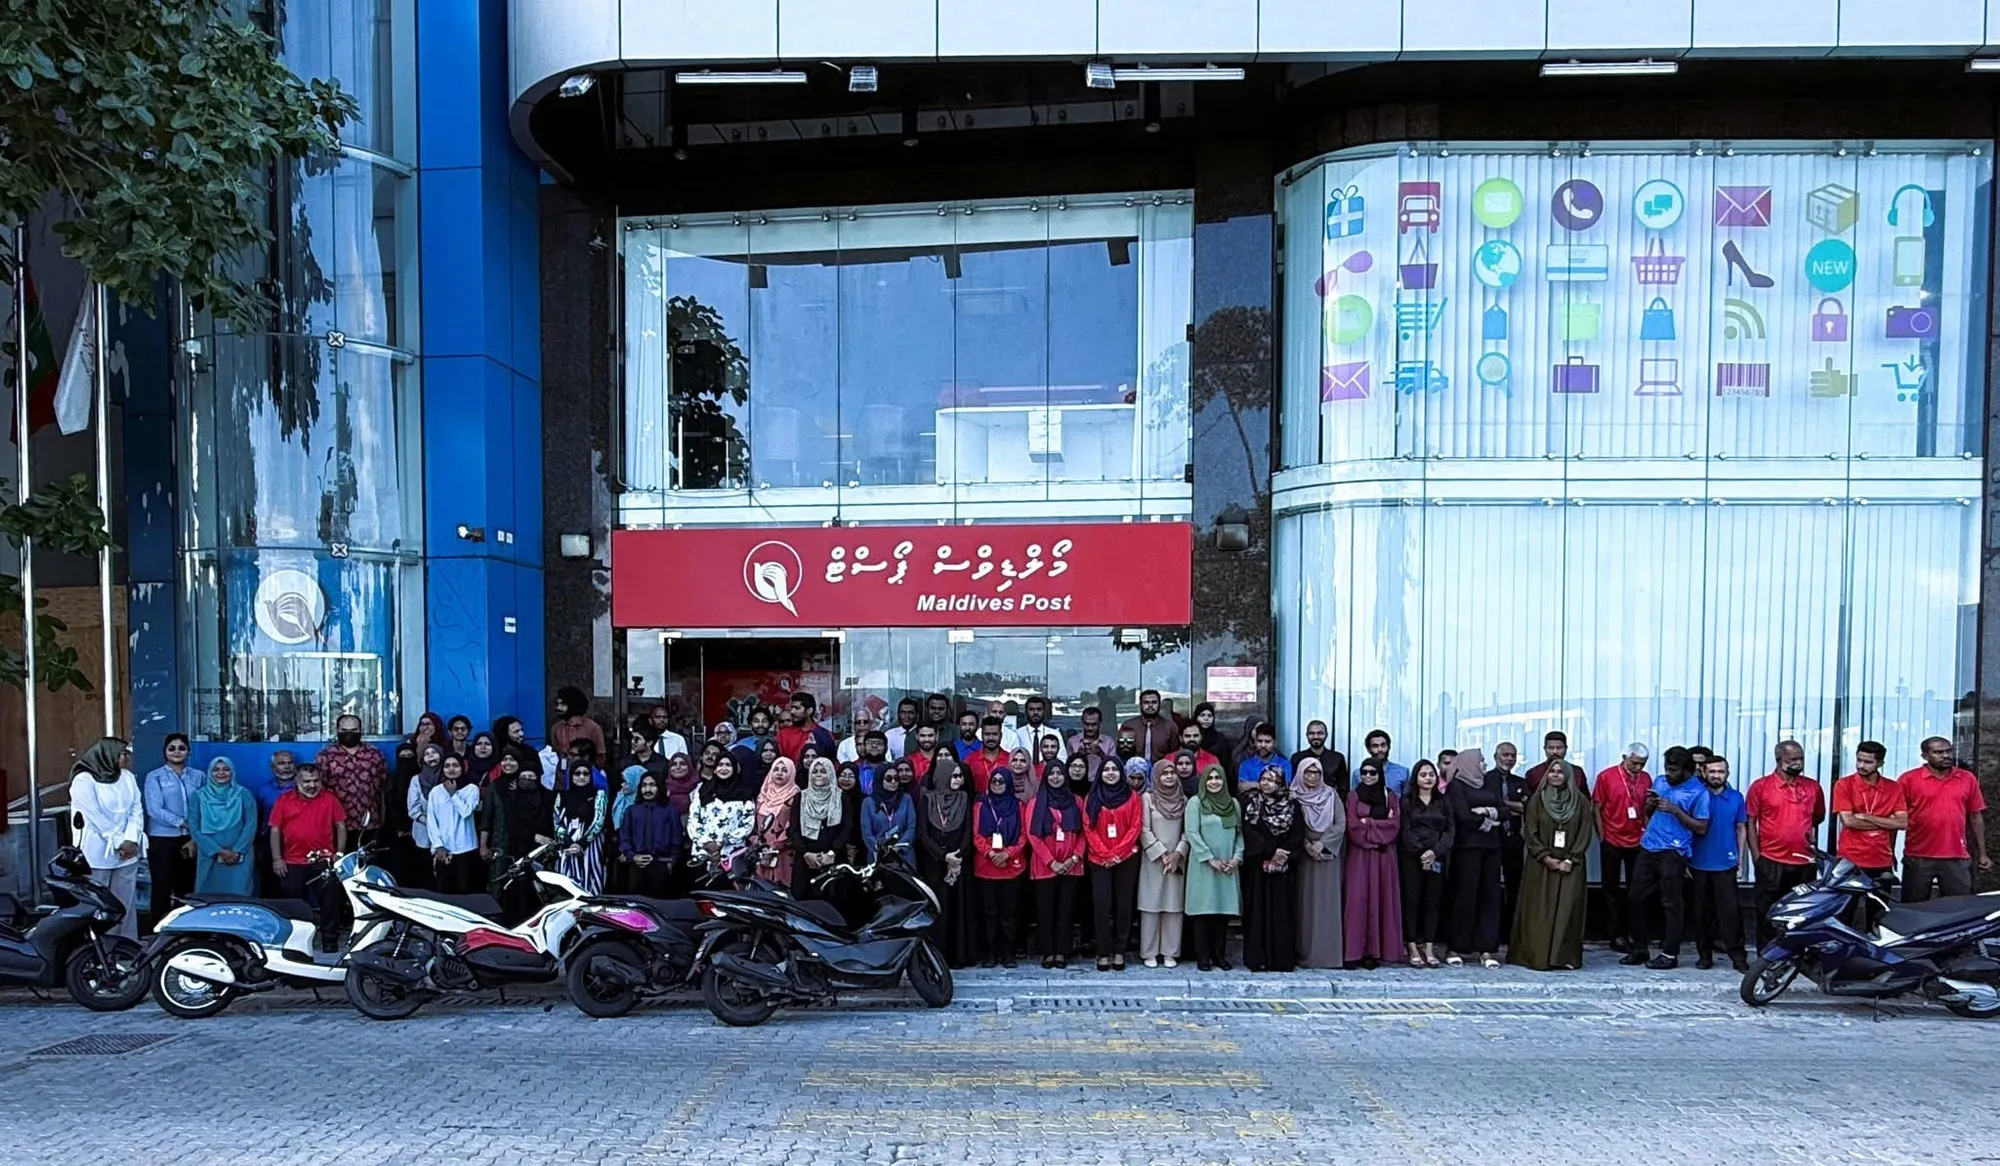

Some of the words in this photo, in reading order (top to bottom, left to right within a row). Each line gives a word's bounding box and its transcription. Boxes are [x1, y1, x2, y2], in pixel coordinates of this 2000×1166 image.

[1812, 260, 1848, 275] NEW
[825, 540, 914, 584] ޕޯސްޓް
[932, 539, 1073, 592] މޯލްޑިވްސް
[916, 594, 1014, 612] Maldives
[1019, 593, 1072, 611] Post
